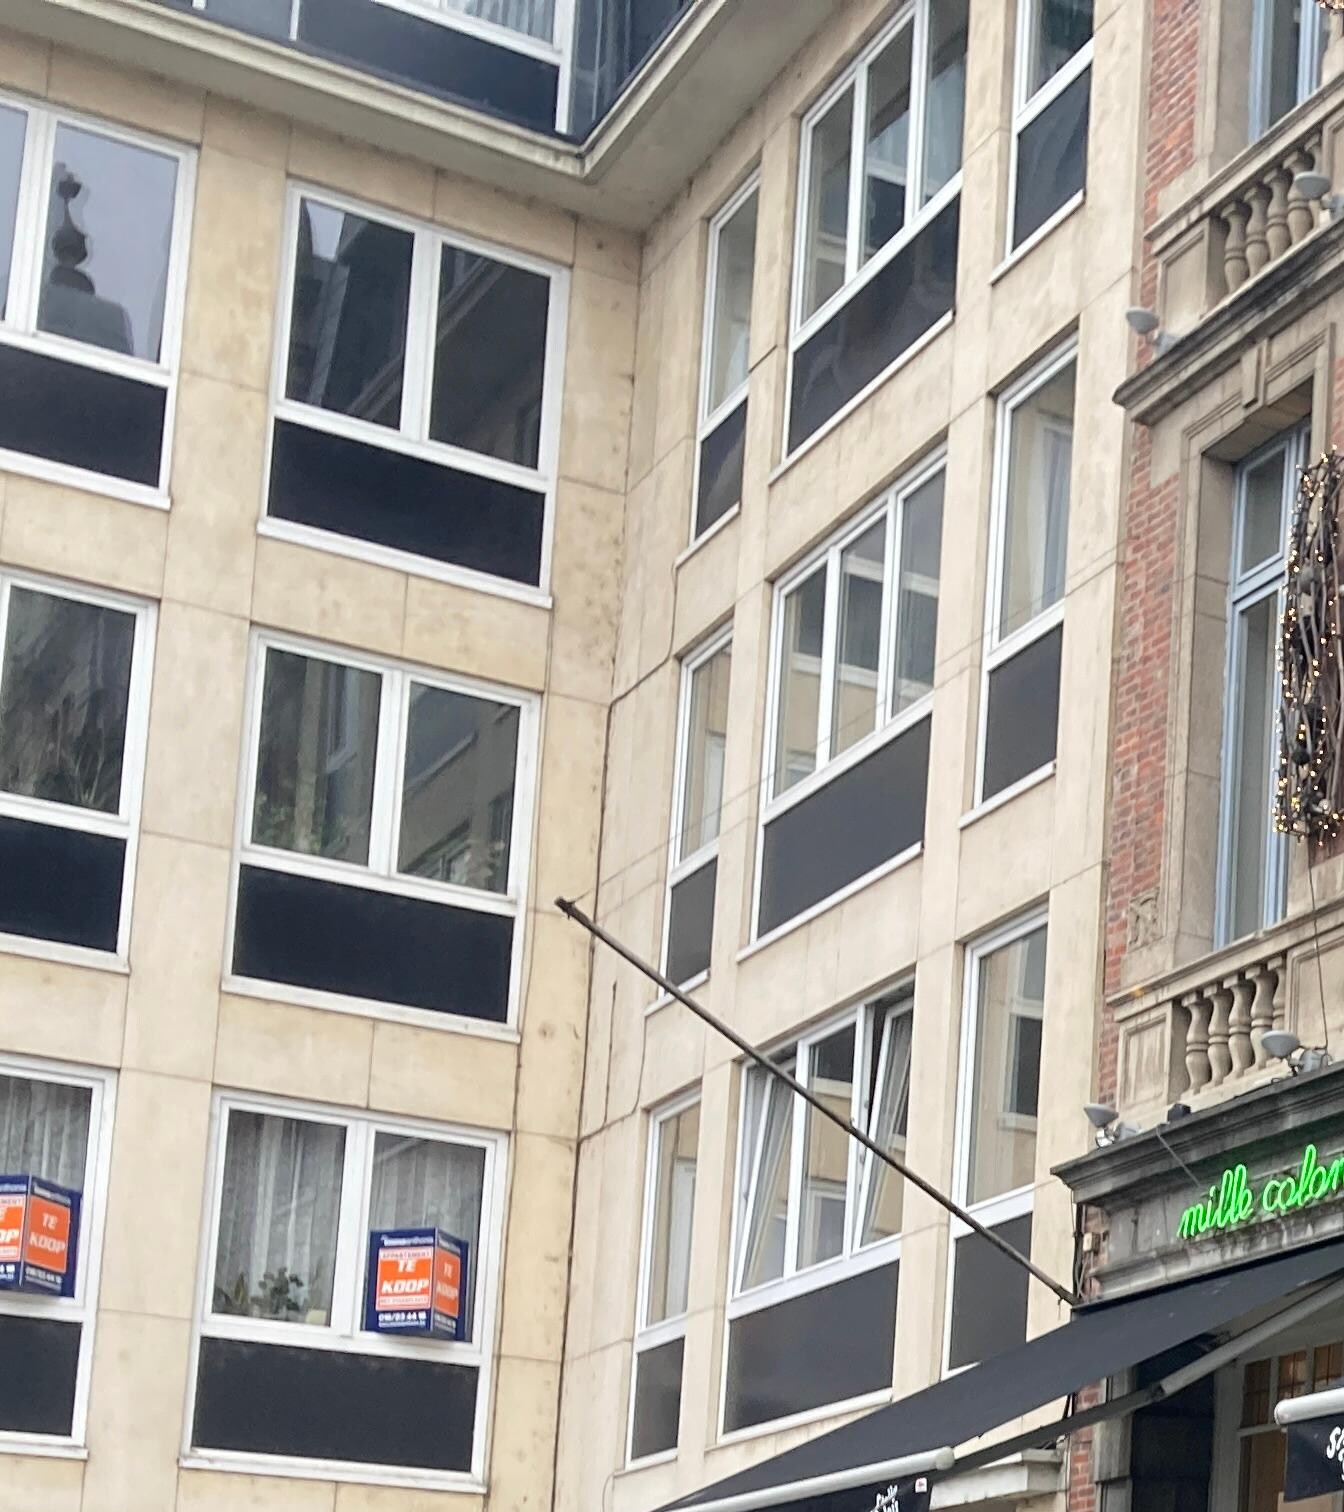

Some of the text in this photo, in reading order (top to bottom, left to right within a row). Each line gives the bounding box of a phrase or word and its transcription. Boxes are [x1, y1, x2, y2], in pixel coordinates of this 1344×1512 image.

[1177, 1164, 1254, 1238] mille
[29, 1231, 66, 1254] KOOP
[398, 1260, 417, 1273] TE
[382, 1279, 430, 1294] KOOP
